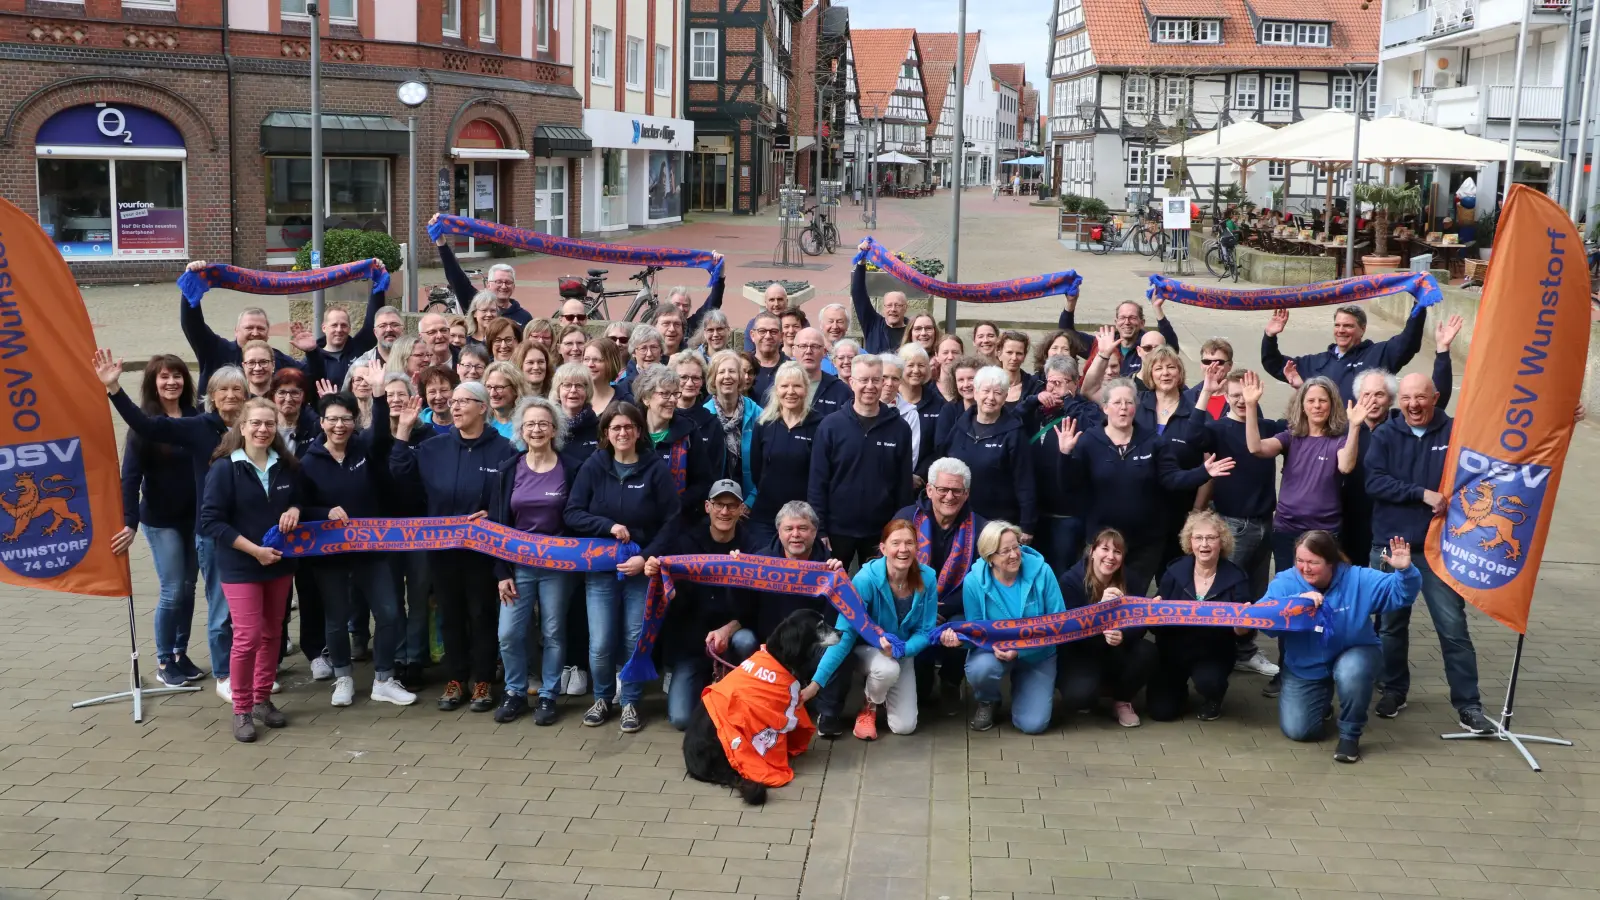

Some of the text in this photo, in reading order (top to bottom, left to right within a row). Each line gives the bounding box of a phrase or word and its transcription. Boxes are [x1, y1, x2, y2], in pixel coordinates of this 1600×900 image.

[97, 107, 133, 143] O2
[118, 201, 155, 210] yourfone
[0, 231, 41, 433] OSV Wuns
[1500, 227, 1567, 452] OSV Wunstorf
[1459, 450, 1552, 489] OSV
[344, 525, 553, 559] OSV Wunstorf e.V.
[358, 519, 387, 527] TOLLER
[391, 518, 446, 527] SPORTVEREIN
[503, 528, 545, 543] WUNSTORF
[0, 538, 88, 561] WUNSTORF
[367, 542, 410, 550] GEWINNEN
[474, 543, 492, 551] ABER
[496, 549, 519, 560] IMMER
[1442, 540, 1517, 577] WUNSTORF
[24, 556, 70, 572] 74 e.V.
[684, 562, 808, 585] Wunstorf
[1451, 561, 1491, 584] 74 e.V.
[728, 577, 755, 586] IMMER
[766, 583, 788, 591] ABER
[1019, 603, 1250, 640] OSV Wunstorf e.V.
[1031, 614, 1061, 625] TOLLER
[1064, 600, 1122, 619] SPORTVEREIN
[1025, 638, 1040, 646] WIR
[1044, 630, 1089, 643] GEWINNEN
[1118, 616, 1146, 626] IMMER
[754, 667, 777, 684] OSV
